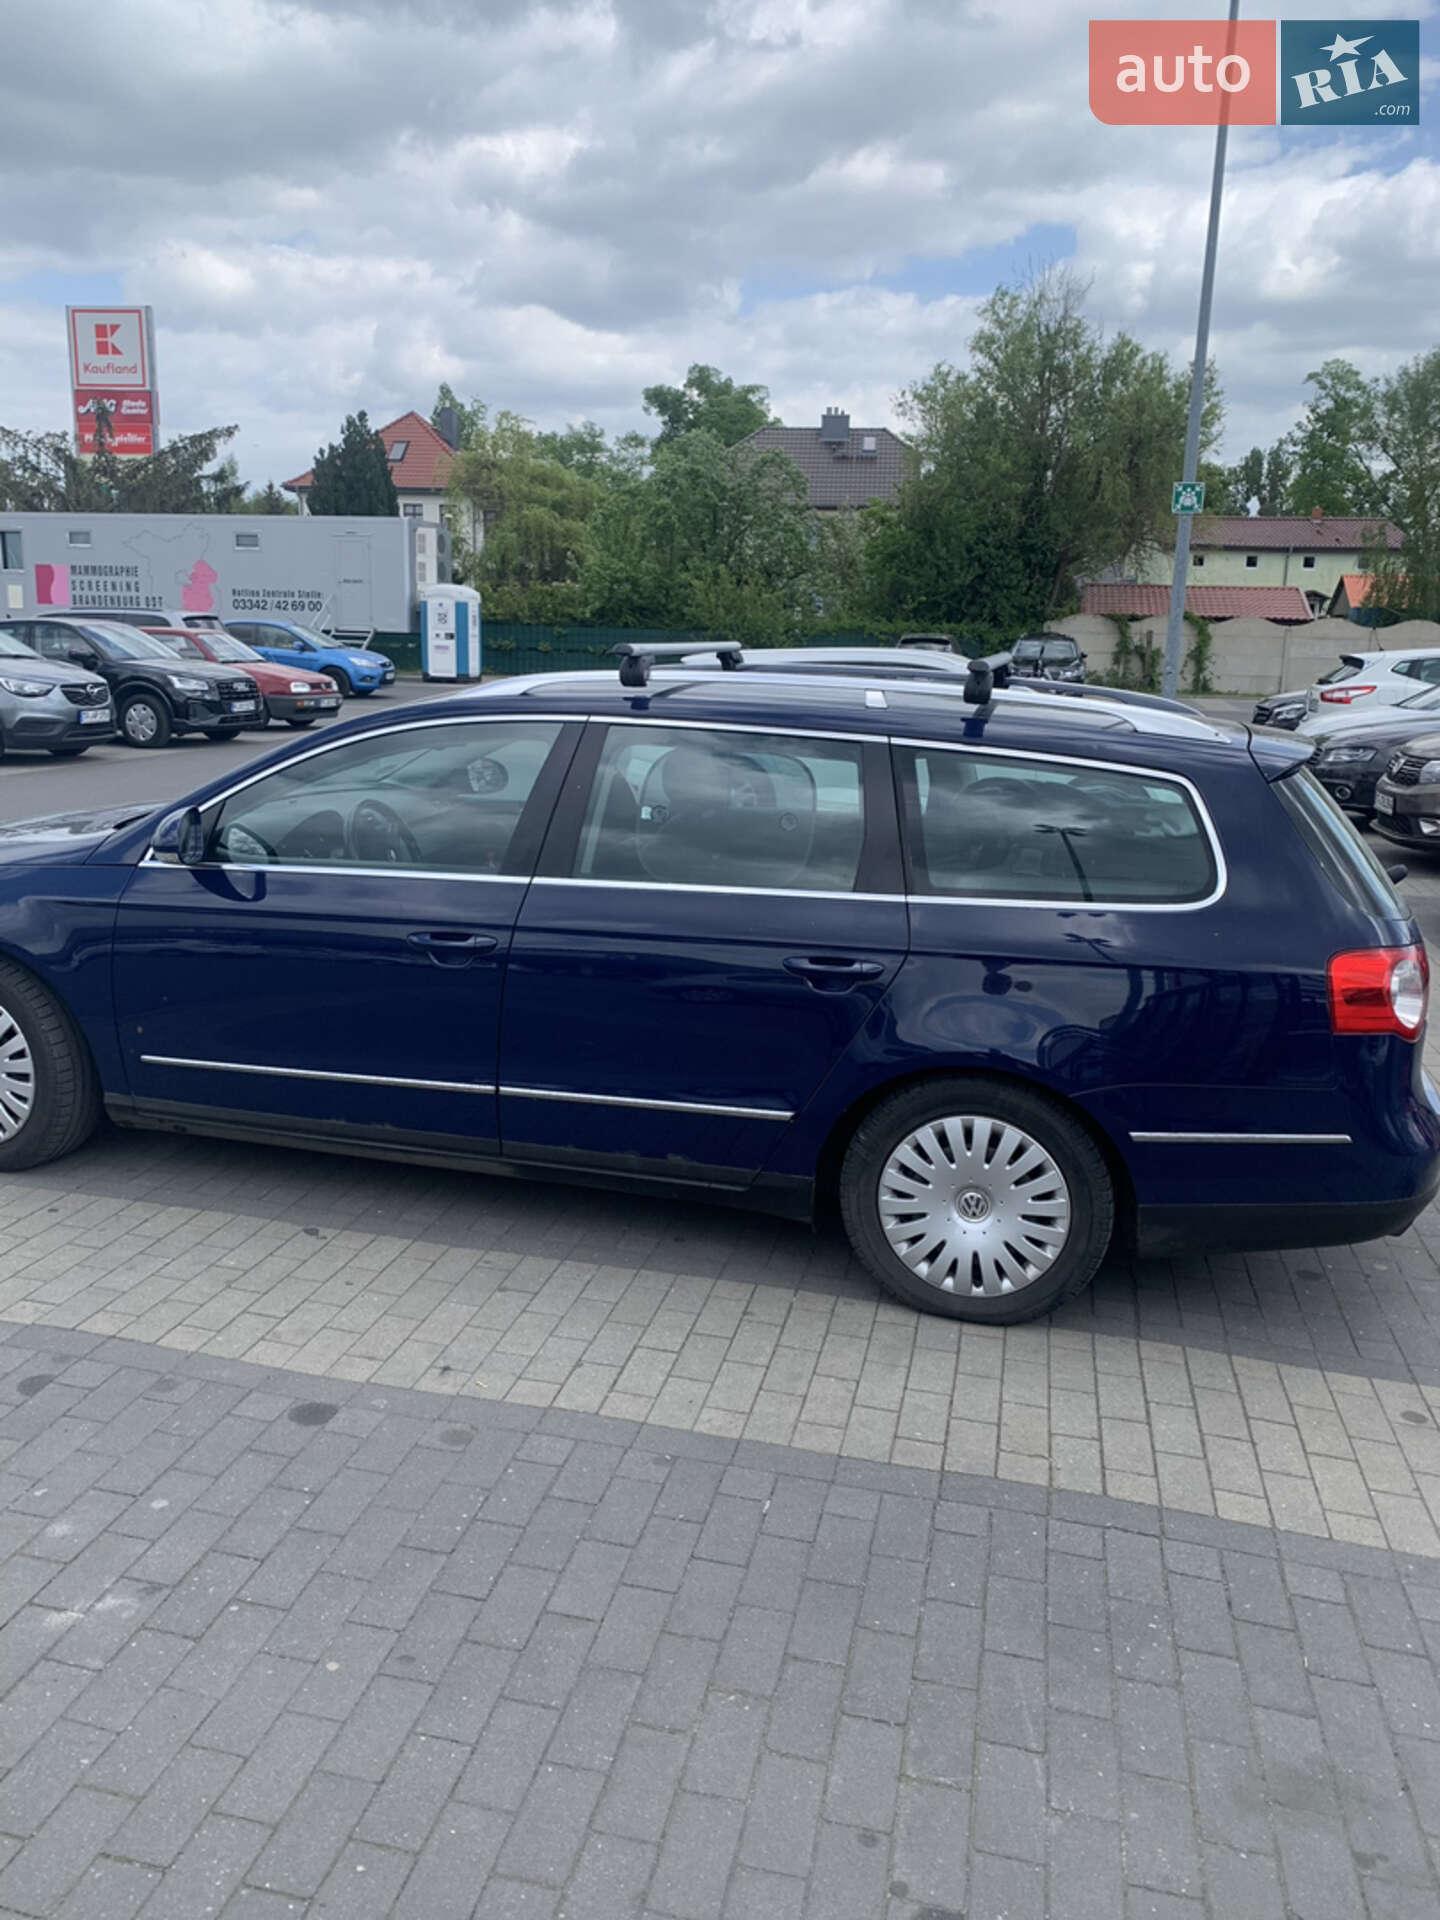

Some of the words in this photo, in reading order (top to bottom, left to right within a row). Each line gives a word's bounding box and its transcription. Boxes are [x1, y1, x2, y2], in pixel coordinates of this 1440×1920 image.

[83, 362, 138, 374] Kaufland
[70, 565, 139, 577] MAMMOGRAPHIE
[71, 580, 140, 592] SCREENING
[72, 594, 141, 607] BRANDENBURG
[145, 596, 163, 607] OST
[307, 600, 323, 612] 00
